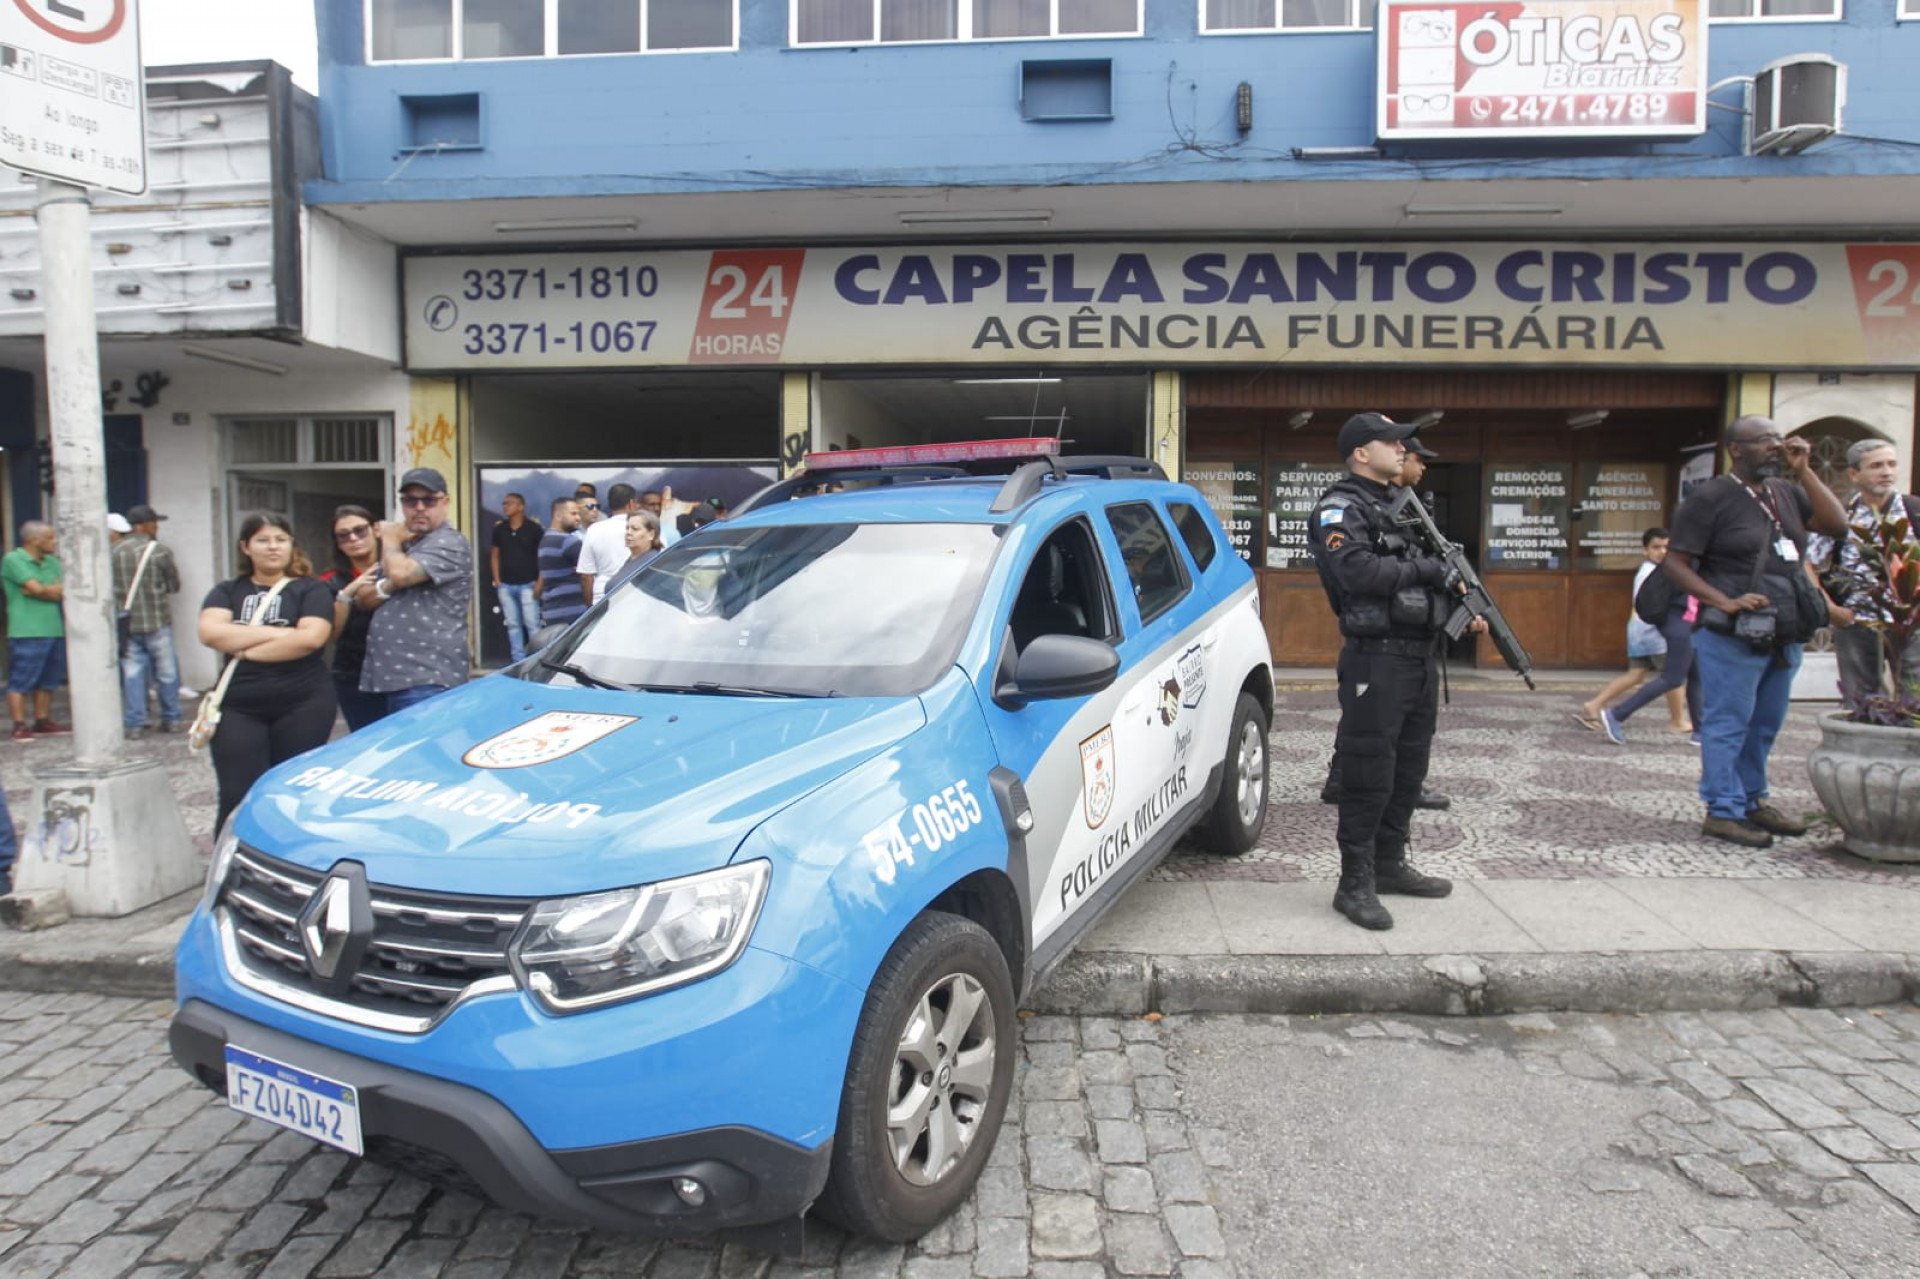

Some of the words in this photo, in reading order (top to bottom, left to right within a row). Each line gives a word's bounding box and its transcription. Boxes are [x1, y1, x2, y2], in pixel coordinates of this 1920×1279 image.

[1459, 12, 1685, 66] ÓTICAS
[1544, 62, 1683, 90] Biarritz
[1500, 94, 1669, 121] 2471.4789
[462, 265, 658, 301] 3371-1810
[834, 253, 1165, 305] CAPELA
[1181, 250, 1477, 304] SANTO
[1494, 250, 1818, 305] CRISTO
[709, 264, 788, 319] 24
[970, 305, 1266, 350] AGÊNCIA
[1286, 305, 1666, 351] FUNERÁRIA
[464, 321, 658, 355] 3371-1067
[695, 332, 782, 356] HORAS
[1279, 472, 1343, 485] SERVIÇOS
[1494, 470, 1562, 485] REMOÇÕES
[1596, 470, 1647, 482] AGÊNCIA
[1276, 487, 1309, 497] PARA
[1491, 484, 1566, 499] CREMAÇÕES
[1589, 484, 1654, 497] FUNERÁRIA
[1282, 501, 1291, 511] O
[1581, 501, 1617, 511] SANTO
[1620, 501, 1661, 511] CRISTO
[1222, 520, 1251, 530] 1810
[1279, 520, 1309, 531] 3371
[1279, 534, 1309, 545] 3371
[863, 779, 982, 885] 54-0655
[1060, 821, 1131, 912] POLÍCIA
[1134, 764, 1189, 842] MILITAR
